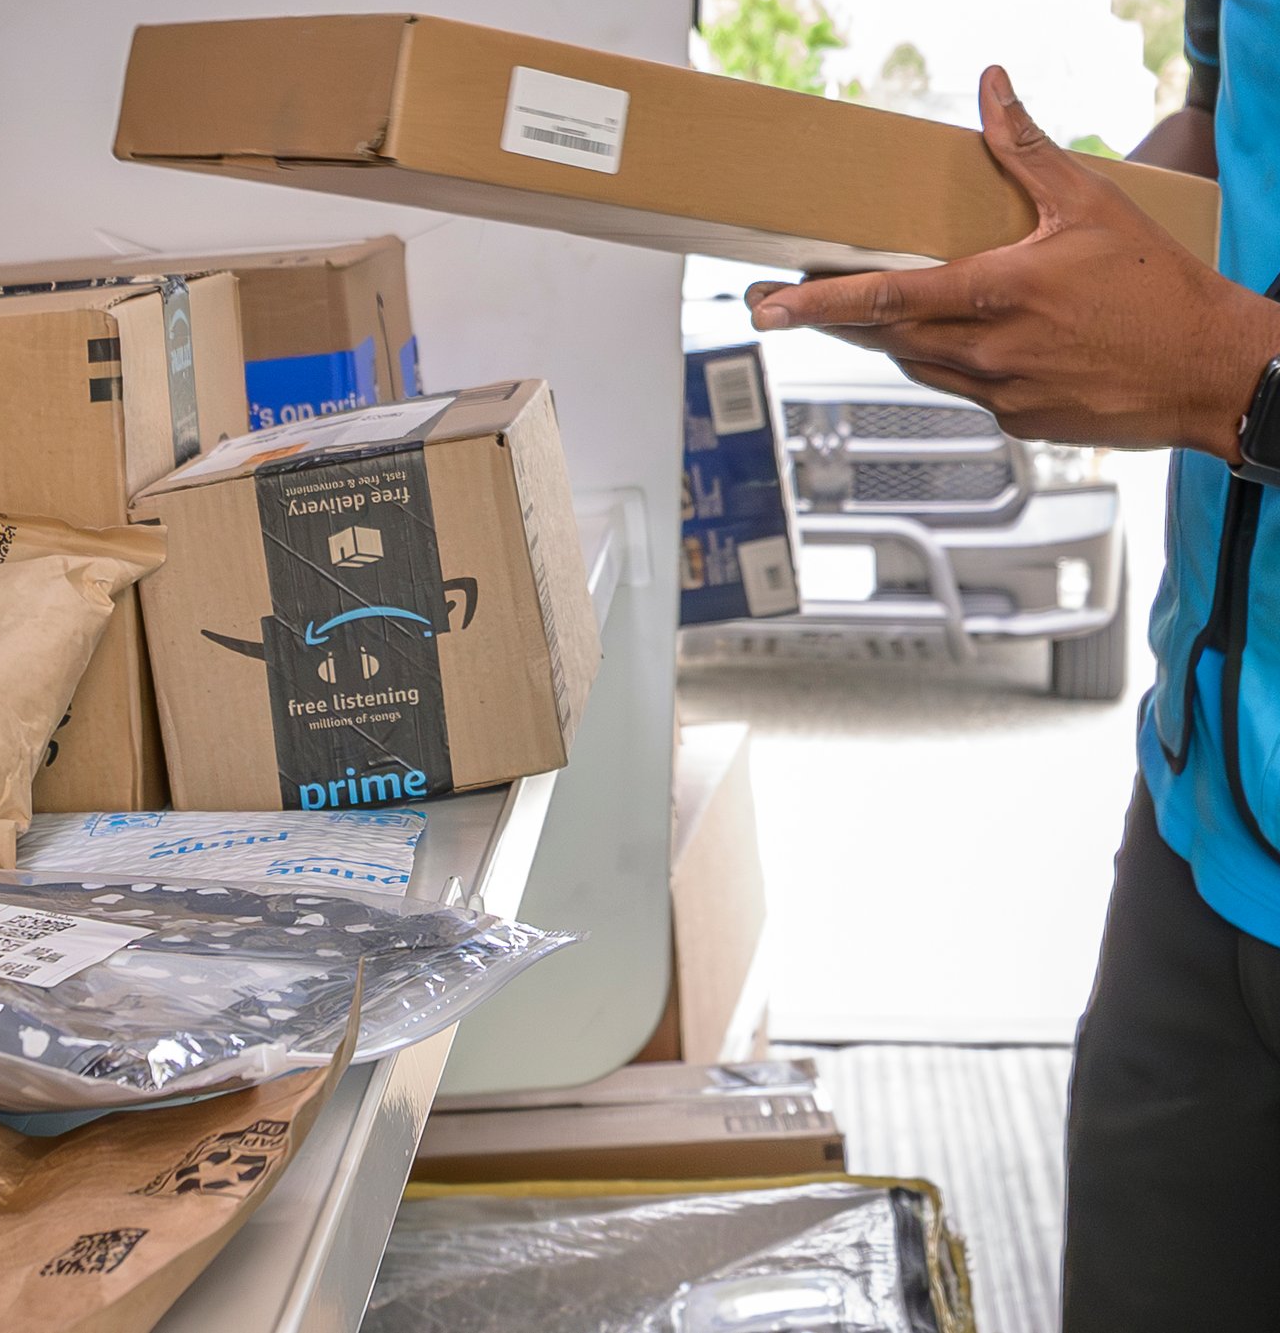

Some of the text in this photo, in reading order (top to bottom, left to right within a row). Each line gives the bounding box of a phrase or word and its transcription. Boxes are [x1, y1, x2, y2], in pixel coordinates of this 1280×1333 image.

[249, 404, 274, 431] 's
[280, 402, 315, 425] on
[286, 469, 407, 497] fast, free & convenient
[287, 486, 411, 517] free delivery
[288, 687, 420, 717] free listening
[309, 711, 402, 731] millions of songs
[299, 767, 428, 812] prime
